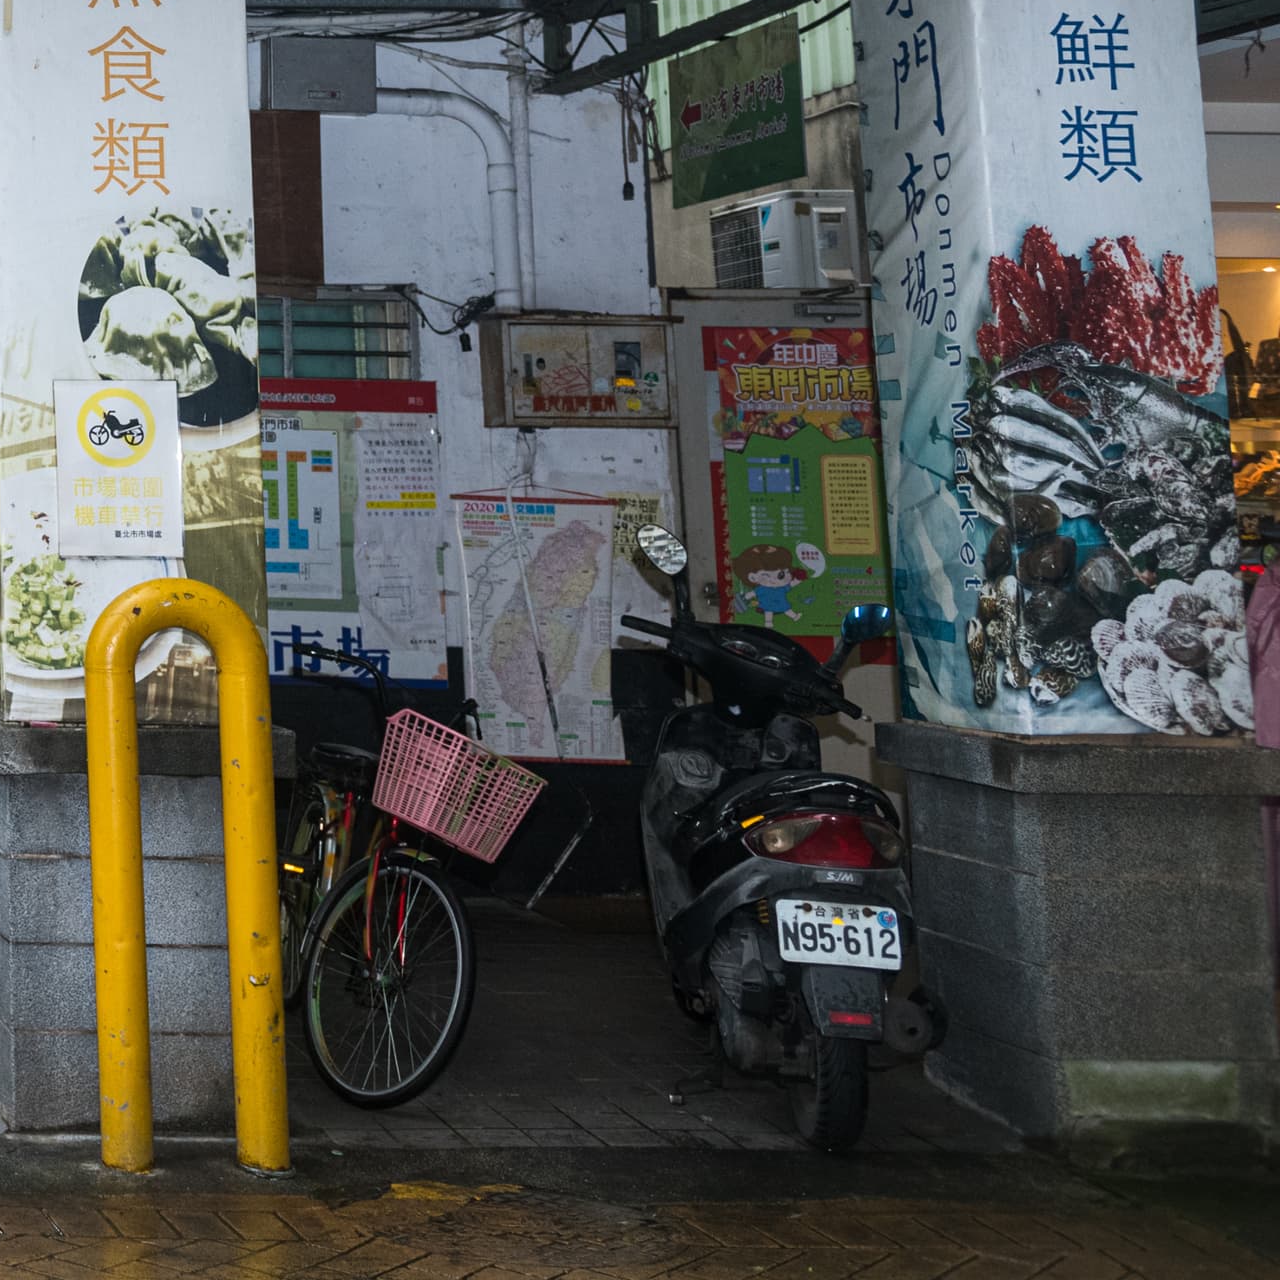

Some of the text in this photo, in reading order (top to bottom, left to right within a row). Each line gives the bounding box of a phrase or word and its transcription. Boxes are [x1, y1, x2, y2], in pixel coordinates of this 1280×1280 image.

[735, 366, 874, 402] 東門市場
[934, 152, 983, 592] Donmen Market
